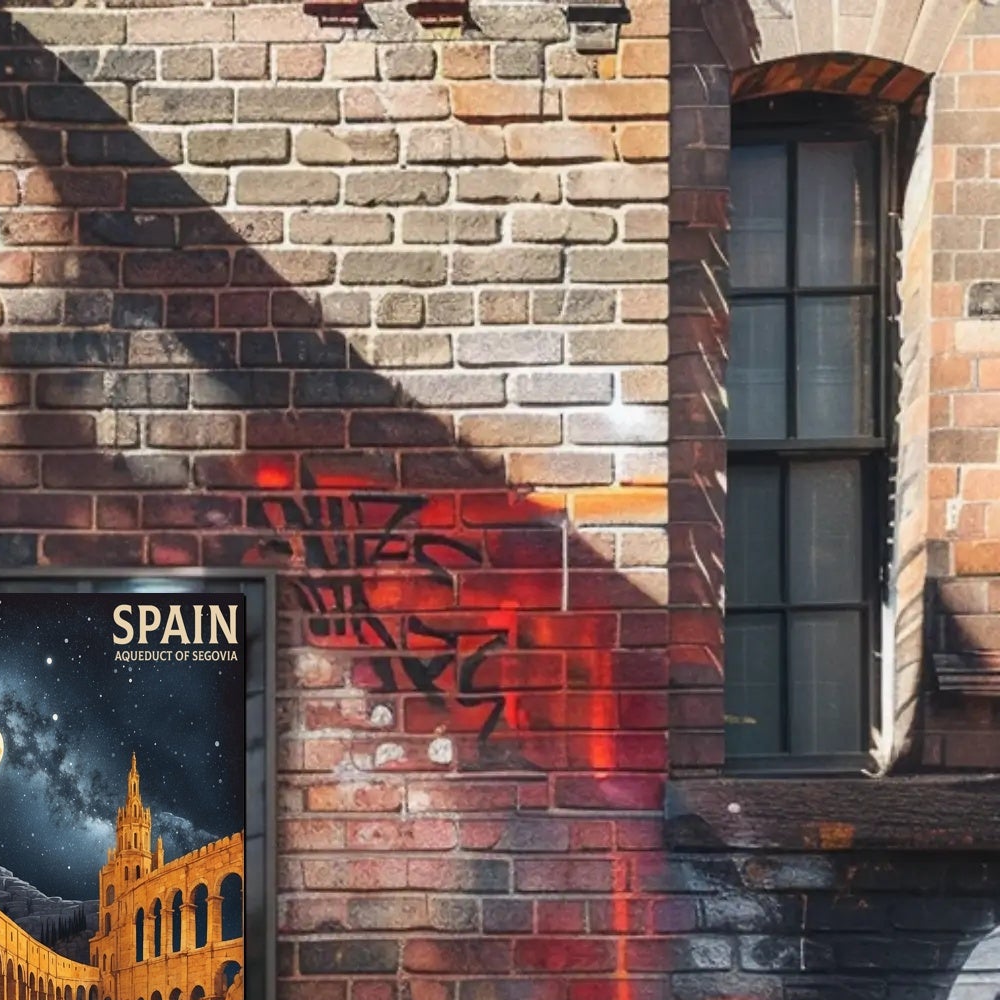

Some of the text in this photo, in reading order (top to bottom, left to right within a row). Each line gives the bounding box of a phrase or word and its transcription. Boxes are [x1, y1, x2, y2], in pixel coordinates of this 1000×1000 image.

[112, 604, 239, 645] SPAIN
[114, 651, 238, 662] AQUEDUCT OF SEGOVIA
